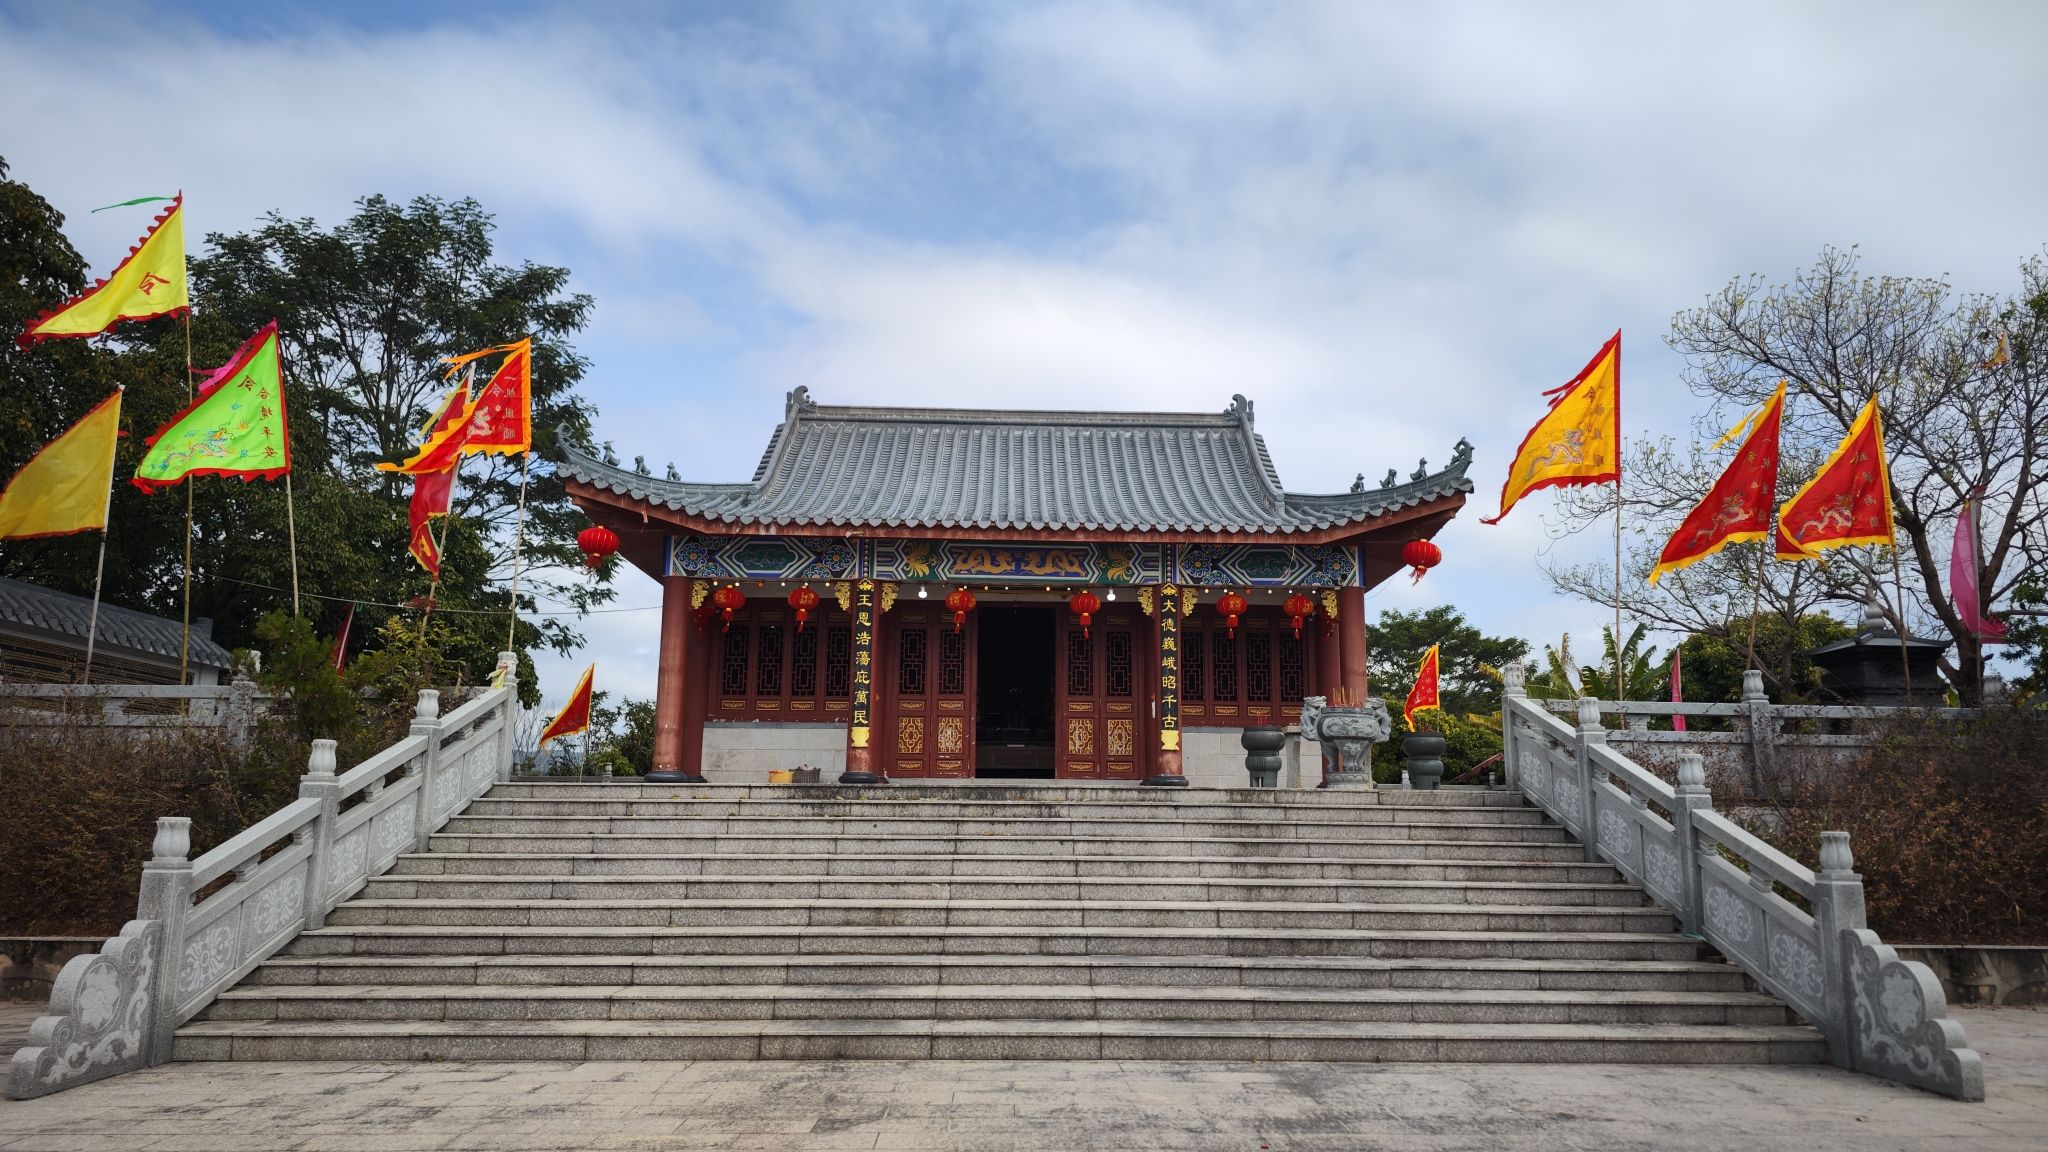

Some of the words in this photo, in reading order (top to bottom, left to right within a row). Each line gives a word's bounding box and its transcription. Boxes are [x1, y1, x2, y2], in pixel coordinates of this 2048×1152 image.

[854, 594, 872, 725] 王恩浩蕩庇萬民
[1161, 599, 1178, 728] 大德巍峨昭千古
